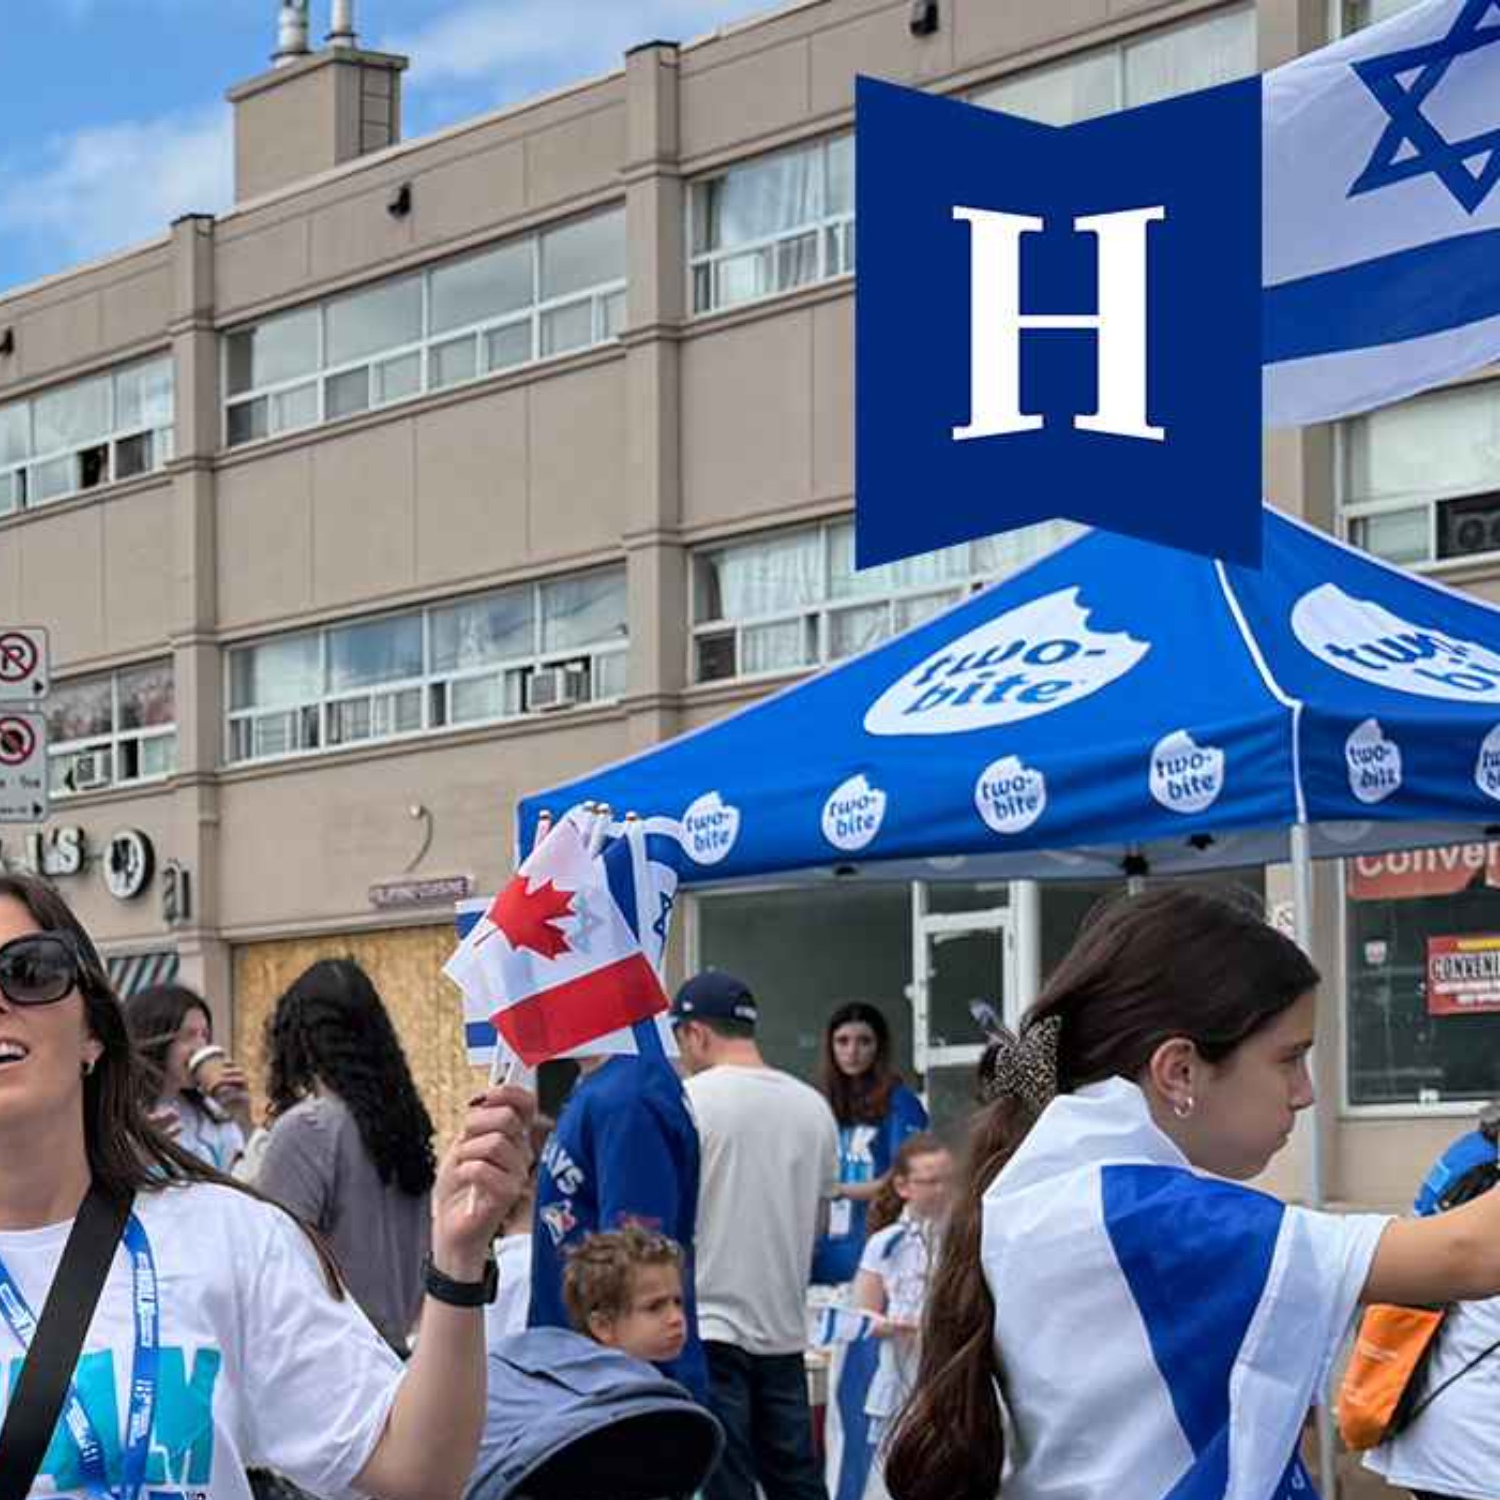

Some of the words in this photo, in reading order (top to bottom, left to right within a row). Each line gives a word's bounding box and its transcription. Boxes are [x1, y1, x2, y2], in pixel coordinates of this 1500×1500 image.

[915, 638, 1106, 687] two-
[903, 671, 1074, 715] bite
[1156, 752, 1212, 778] two-
[982, 774, 1033, 799] two-
[1167, 774, 1215, 800] bite
[829, 796, 878, 817] two-
[994, 793, 1037, 819] bite
[836, 813, 875, 837] bite
